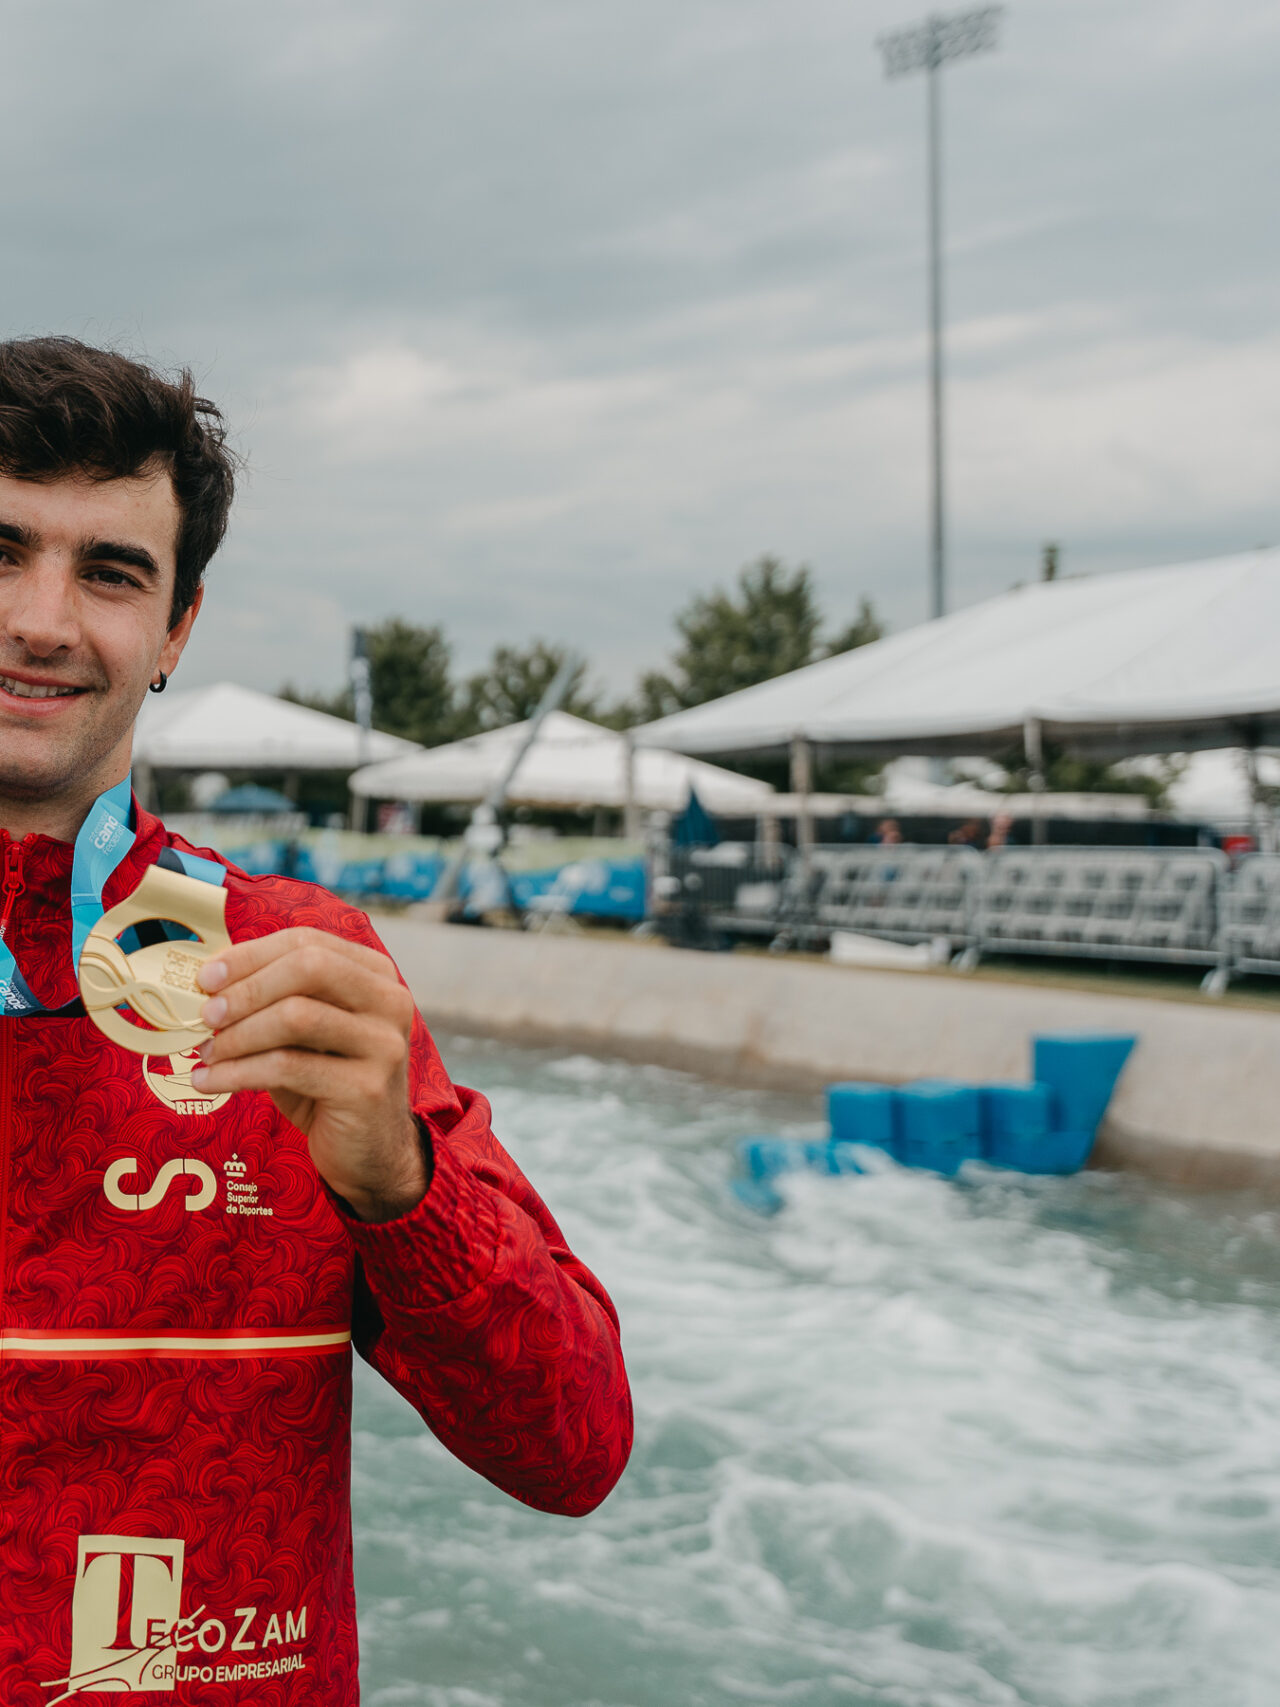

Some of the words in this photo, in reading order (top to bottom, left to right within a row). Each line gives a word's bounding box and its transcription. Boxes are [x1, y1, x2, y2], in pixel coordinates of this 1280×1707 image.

[175, 1100, 213, 1115] RFEP
[226, 1180, 258, 1194] Consejo
[227, 1191, 259, 1205] Superior
[226, 1203, 238, 1214] de
[152, 1664, 214, 1683] GRUPO
[216, 1653, 306, 1683] EMPRESARIAL
